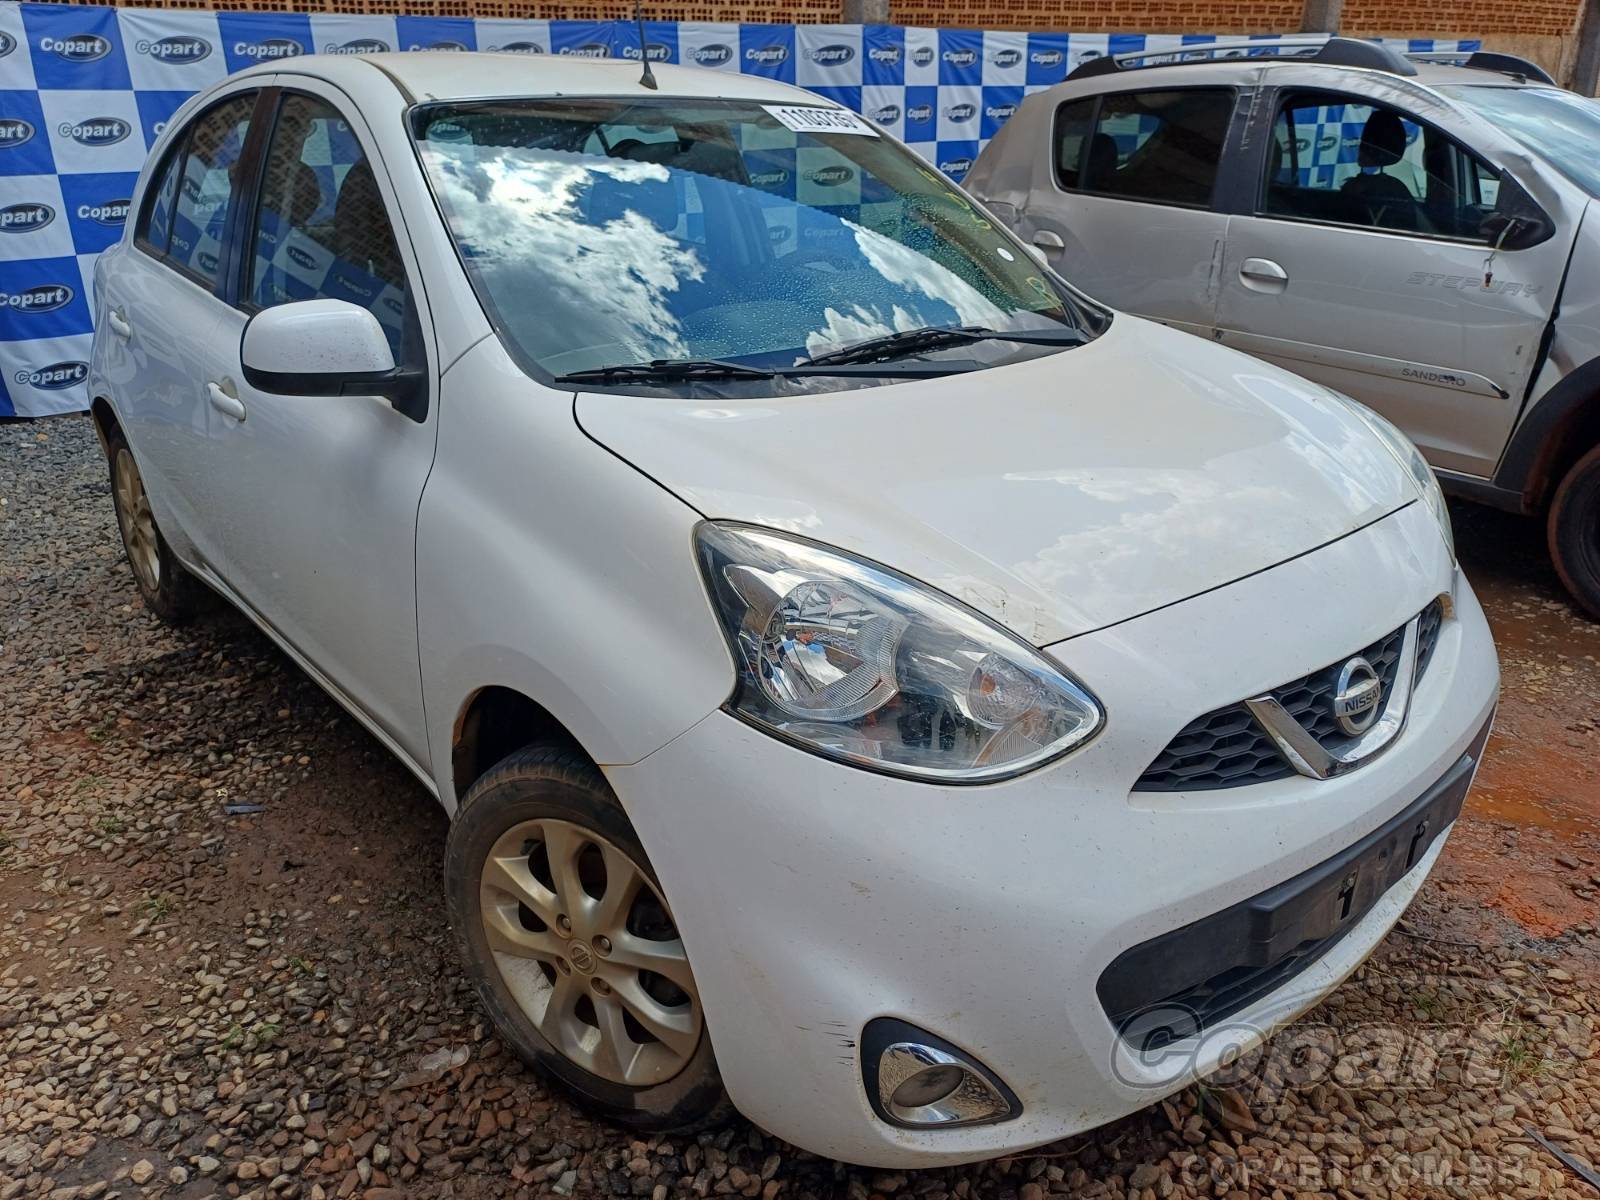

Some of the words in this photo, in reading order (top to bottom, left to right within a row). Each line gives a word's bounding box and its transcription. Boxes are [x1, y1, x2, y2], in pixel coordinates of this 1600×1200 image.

[40, 37, 102, 56] Copart
[135, 39, 201, 57] Copart
[234, 42, 296, 58] Copart
[622, 47, 665, 60] Copart
[685, 47, 726, 61] Copart
[745, 49, 784, 61] Copart
[802, 48, 847, 61] Copart
[942, 51, 974, 64] Copart
[1030, 53, 1060, 65] Copart
[907, 104, 931, 120] Copart
[985, 105, 1016, 118] Copart
[57, 122, 120, 140] Copart
[940, 160, 970, 173] Copart
[749, 171, 785, 185] Copart
[802, 169, 846, 182] Copart
[0, 208, 45, 227] part
[77, 204, 131, 221] Copar
[0, 288, 64, 308] Copart
[15, 365, 84, 385] Copart
